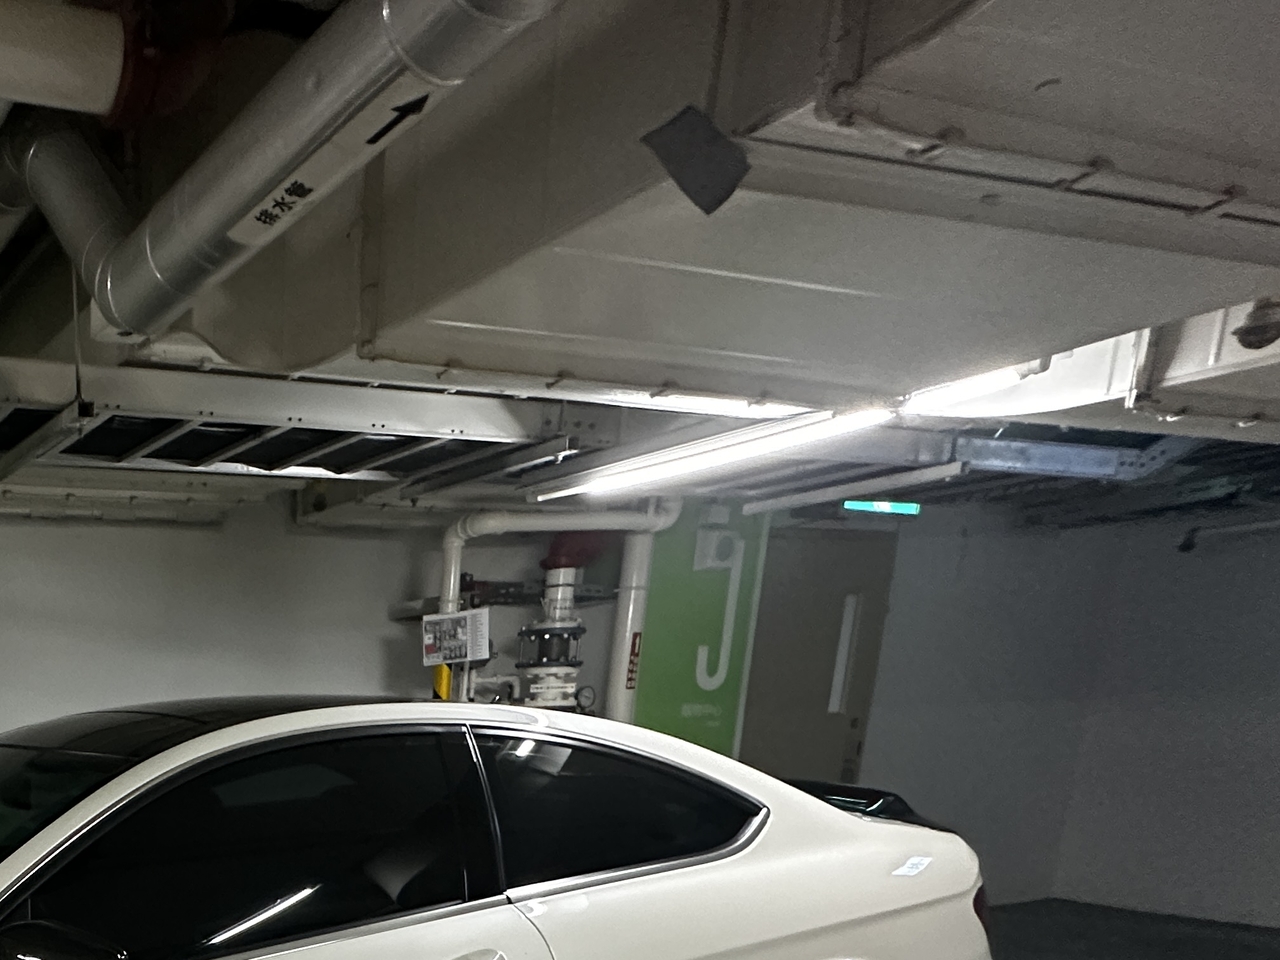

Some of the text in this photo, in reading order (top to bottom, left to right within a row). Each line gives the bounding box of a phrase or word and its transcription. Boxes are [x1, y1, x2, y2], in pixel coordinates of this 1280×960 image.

[254, 180, 314, 226] 排水管
[695, 538, 746, 691] J
